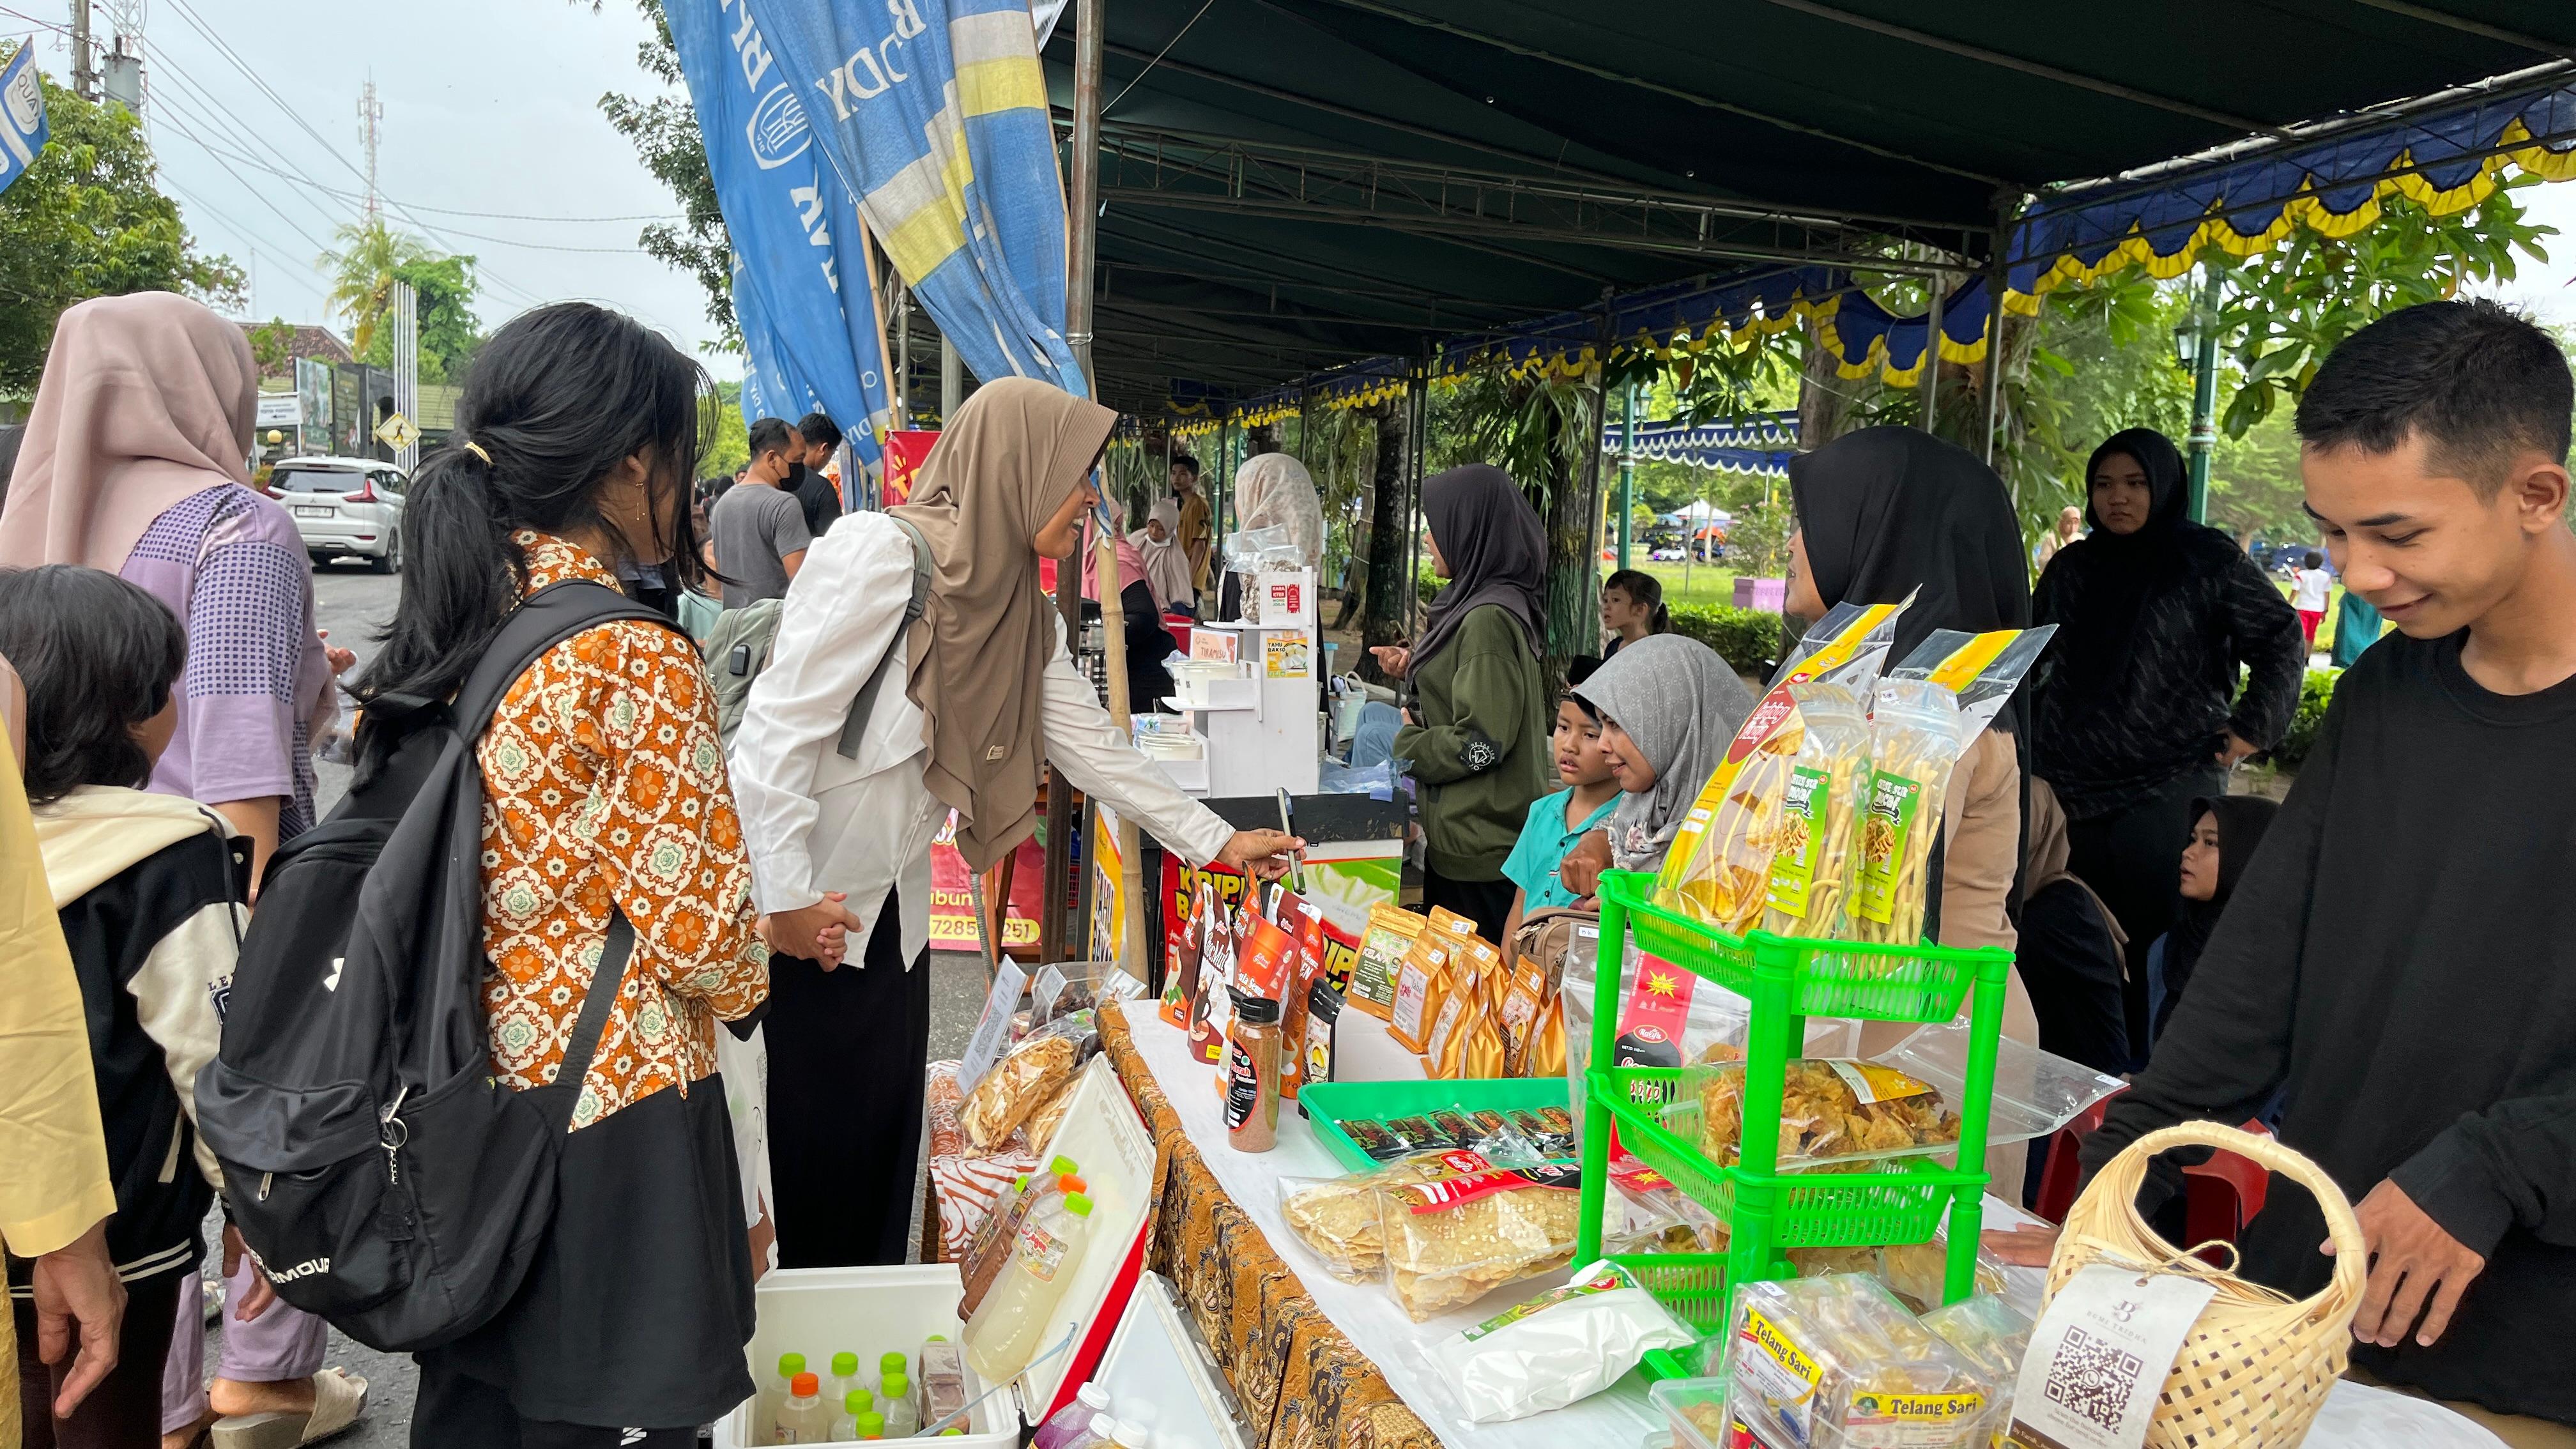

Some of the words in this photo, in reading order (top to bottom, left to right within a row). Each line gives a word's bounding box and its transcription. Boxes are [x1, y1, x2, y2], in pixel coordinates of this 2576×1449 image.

[1201, 647, 1226, 659] TIRAMISU
[1756, 1320, 1788, 1361] Telang
[1788, 1351, 1813, 1381] Sari
[1891, 1399, 1943, 1416] Telang
[1947, 1398, 1977, 1414] Sari
